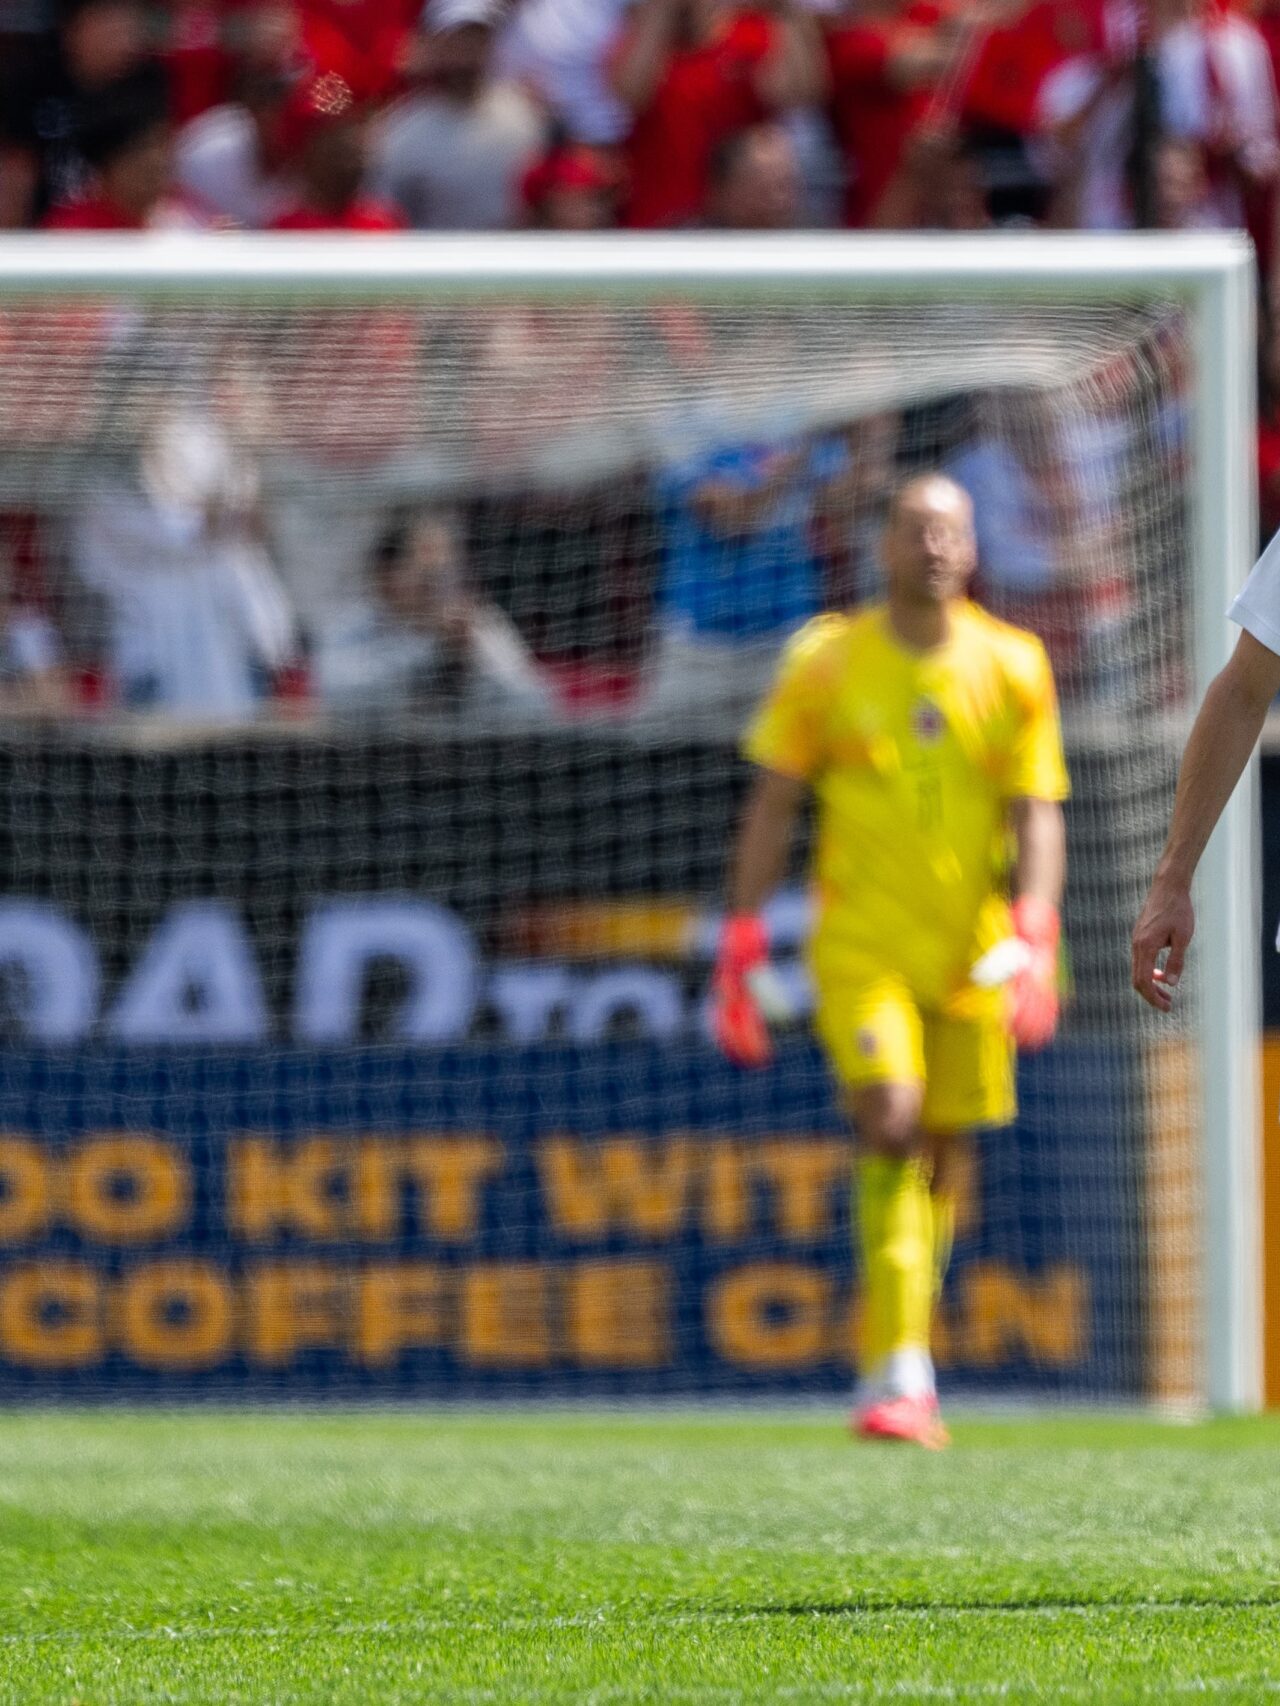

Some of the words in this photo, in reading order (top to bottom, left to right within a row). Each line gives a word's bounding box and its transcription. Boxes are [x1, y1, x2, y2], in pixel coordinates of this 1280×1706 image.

[225, 1133, 502, 1243] KIT
[534, 1132, 984, 1243] WIT
[0, 1258, 674, 1369] COFFEE
[706, 1258, 1092, 1370] CN
